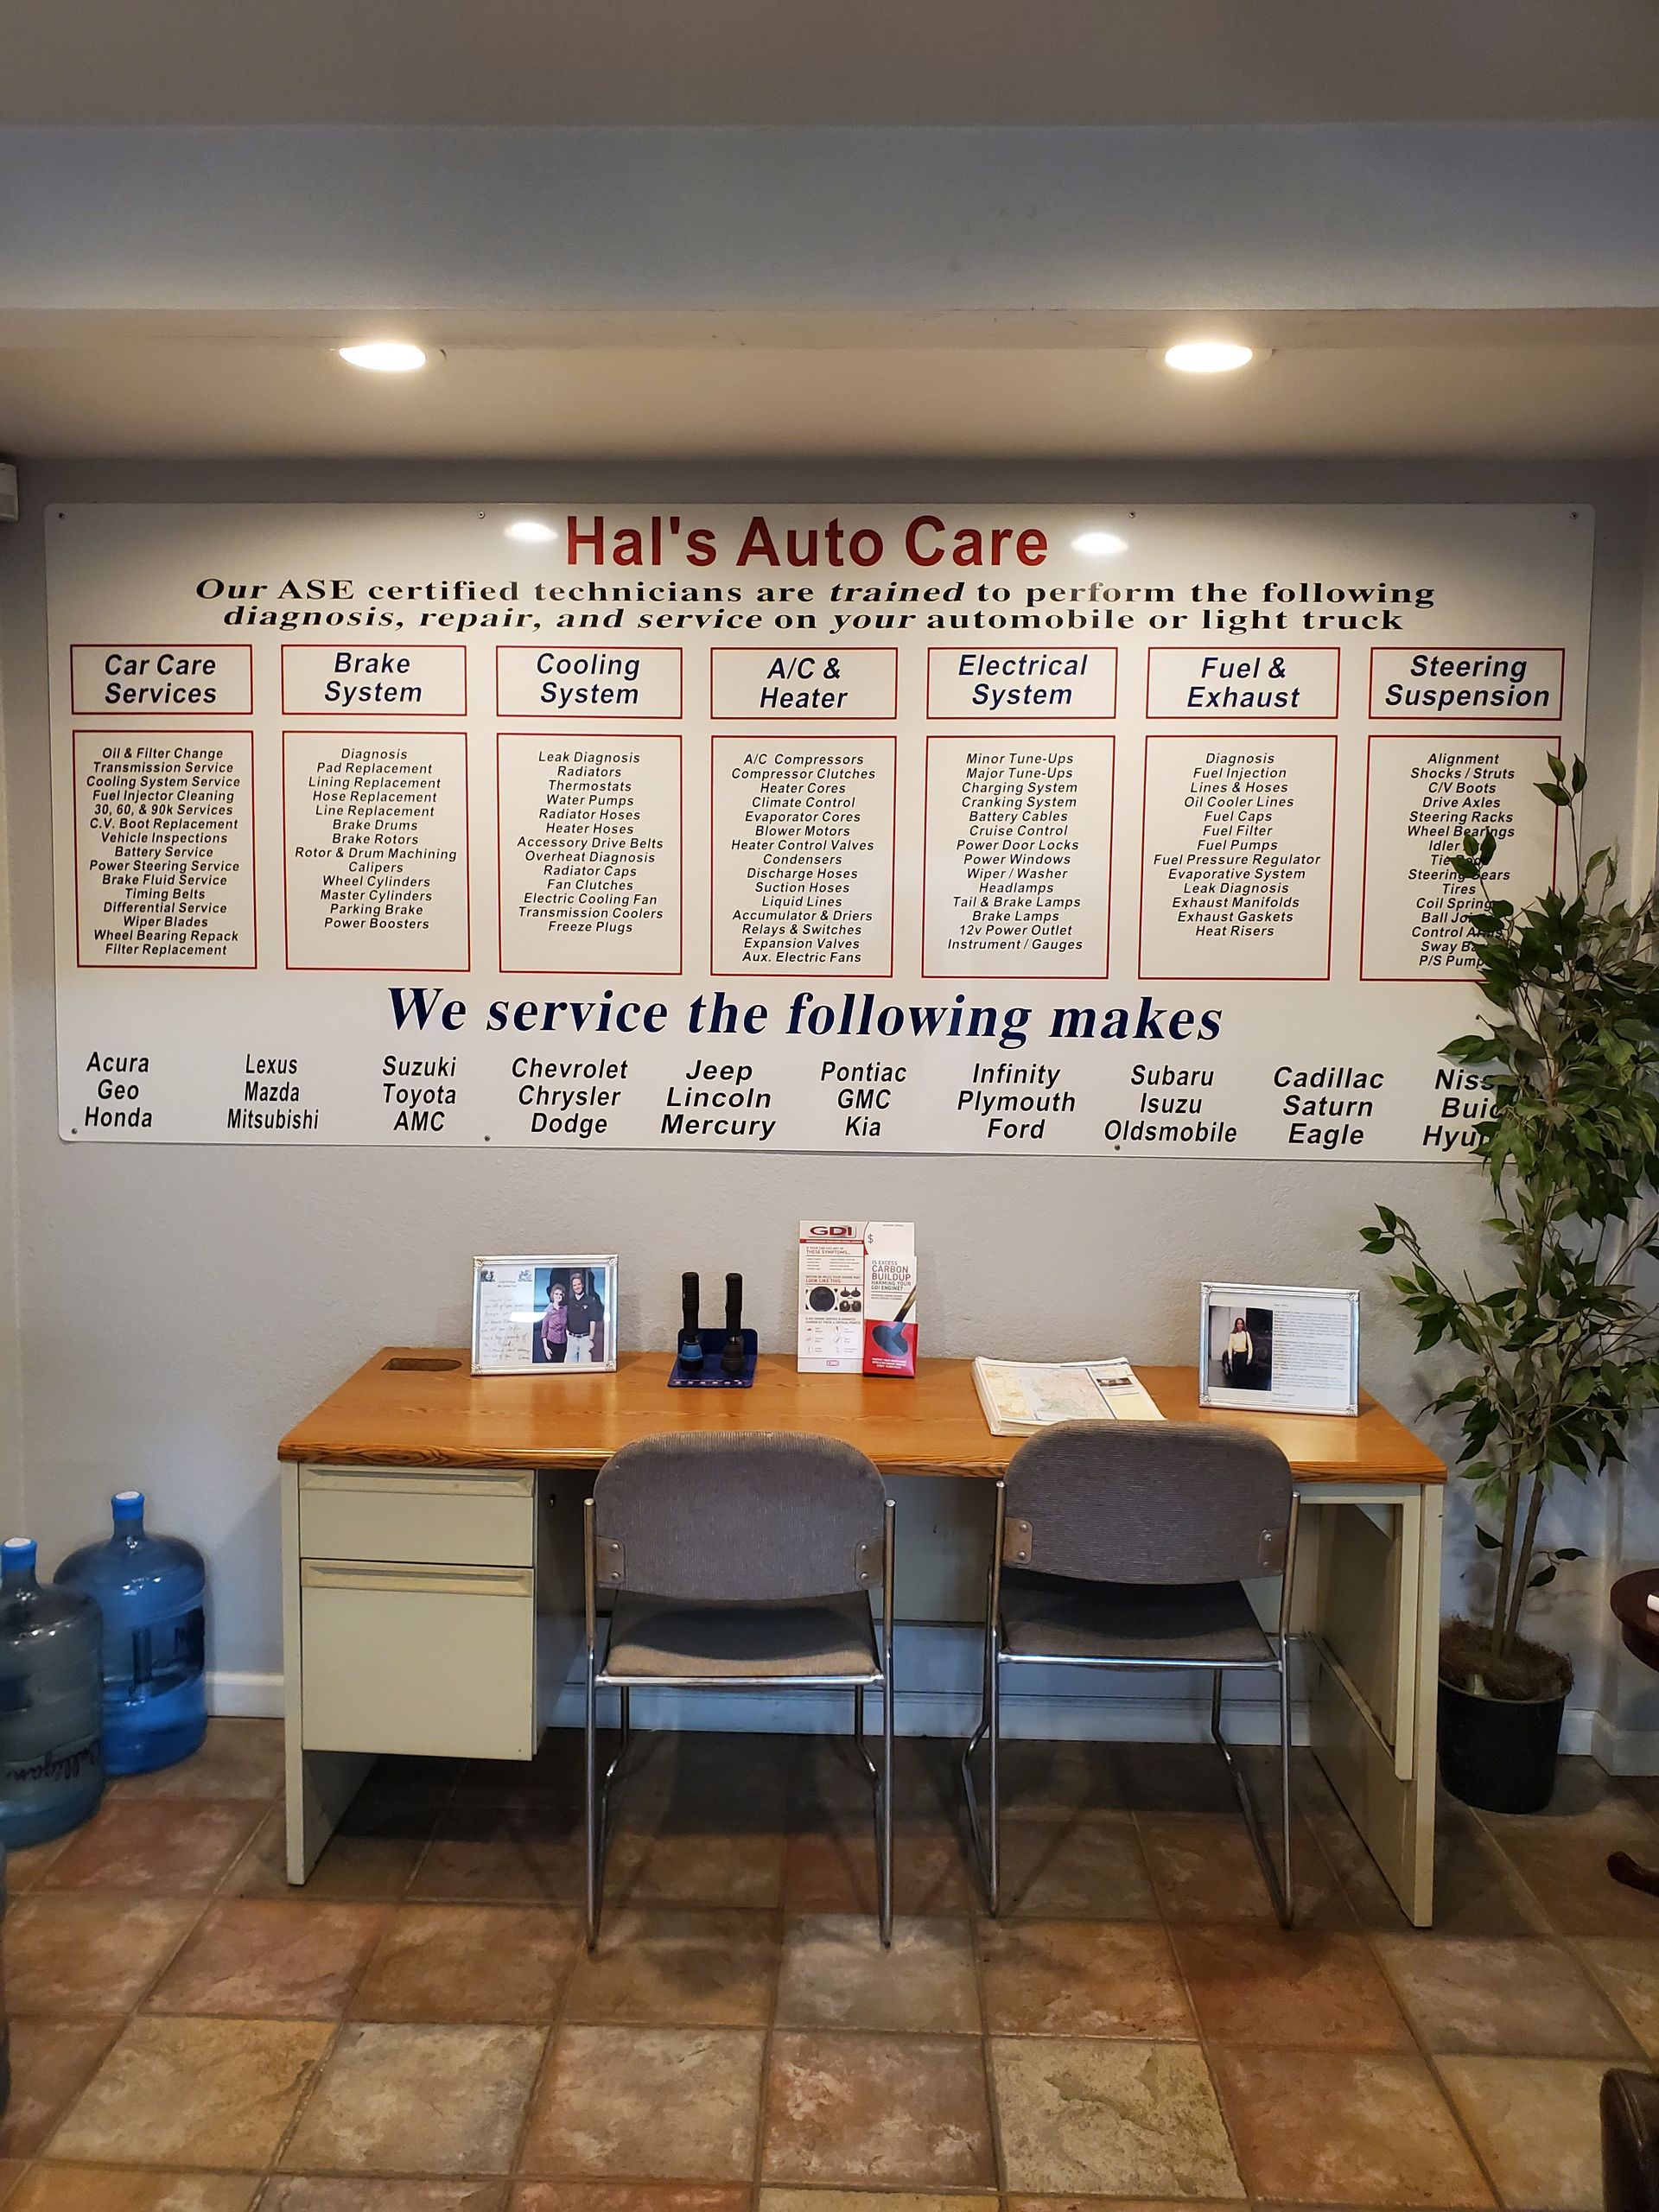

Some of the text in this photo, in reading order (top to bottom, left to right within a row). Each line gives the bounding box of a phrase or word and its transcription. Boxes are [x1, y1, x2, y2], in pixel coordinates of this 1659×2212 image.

[568, 517, 1047, 567] Hal's Auto Care
[196, 578, 1435, 609] Our ASE certified technicians are trained to perform the following
[224, 606, 1403, 634] diagnosis, repair, and service on your automobile or light truck
[105, 654, 215, 676] Car Care
[334, 652, 410, 673] Brake
[537, 653, 639, 681] Cooling
[766, 658, 840, 679] A/C &
[958, 654, 1088, 676] Electrical
[1201, 657, 1286, 678] Fuel &
[1410, 655, 1527, 683] Steering
[105, 683, 216, 704] Services
[325, 681, 422, 707] System
[541, 682, 638, 709] System
[760, 687, 849, 708] Heater
[972, 683, 1071, 710] System
[1187, 686, 1300, 708] Exhaust
[1385, 684, 1549, 711] Suspension
[103, 747, 223, 761] Oil & Filter Change
[341, 748, 407, 761] Diagnosis
[539, 751, 639, 766] Leak Diagnosis
[744, 753, 863, 767] A/C Compressors
[966, 753, 1073, 766] Minor Tune-Ups
[1206, 753, 1274, 766] Diagnosis
[1427, 753, 1499, 766] Alignment
[317, 762, 432, 776] Pad Replacement
[1411, 767, 1515, 779] Shocks / Struts
[1428, 782, 1497, 793] C/V Boots
[94, 804, 232, 817] 30, 60, & 90k Services
[1422, 797, 1501, 808] Drive Axles
[517, 836, 663, 850] Accessory Drive Belts
[296, 847, 456, 862] Rotor & Drum Machining
[1154, 854, 1321, 868] Fuel Pressure Regulator
[968, 868, 1068, 881] Wiper / Washer
[1168, 868, 1305, 881] Evaporative System
[1442, 884, 1476, 894] Tires
[524, 893, 657, 907] Electric Cooling Fan
[1416, 898, 1494, 912] Coil Spring
[732, 910, 872, 921] Accumulator & Driers
[960, 925, 1072, 935] 12v Power Outlet
[1412, 926, 1464, 938] Control
[742, 951, 861, 963] Aux. Electric Fans
[1419, 956, 1485, 969] P/S Pump
[388, 988, 1222, 1049] We service the following makes
[86, 1052, 149, 1072] Acura
[245, 1053, 297, 1074] Lexus
[383, 1055, 456, 1077] Suzuki
[512, 1058, 628, 1079] Chevrolet
[686, 1059, 752, 1085] Jeep
[821, 1061, 906, 1082] Pontiac
[973, 1063, 1060, 1090] Infinity
[1131, 1065, 1214, 1086] Subaru
[1274, 1066, 1384, 1089] Cadillac
[98, 1079, 139, 1100] Geo
[245, 1081, 299, 1102] Mazda
[383, 1083, 455, 1109] Toyota
[519, 1084, 621, 1111] Chrysler
[667, 1087, 771, 1108] Lincoln
[838, 1089, 891, 1109] GMC
[957, 1090, 1075, 1116] Plymouth
[1141, 1093, 1202, 1114] Isuzu
[1283, 1095, 1372, 1116] Saturn
[1441, 1097, 1503, 1118] Buic
[85, 1106, 152, 1128] Honda
[227, 1109, 319, 1129] Mitsubishi
[393, 1110, 445, 1131] AMC
[531, 1113, 607, 1139] Dodge
[661, 1114, 776, 1141] Mercury
[845, 1116, 880, 1136] Kia
[988, 1118, 1045, 1139] Ford
[1105, 1120, 1236, 1142] Oldsmobile
[1288, 1123, 1363, 1149] Eagle
[810, 1226, 853, 1236] GDI
[868, 1233, 874, 1243] $
[872, 1273, 911, 1281] BUILDUP
